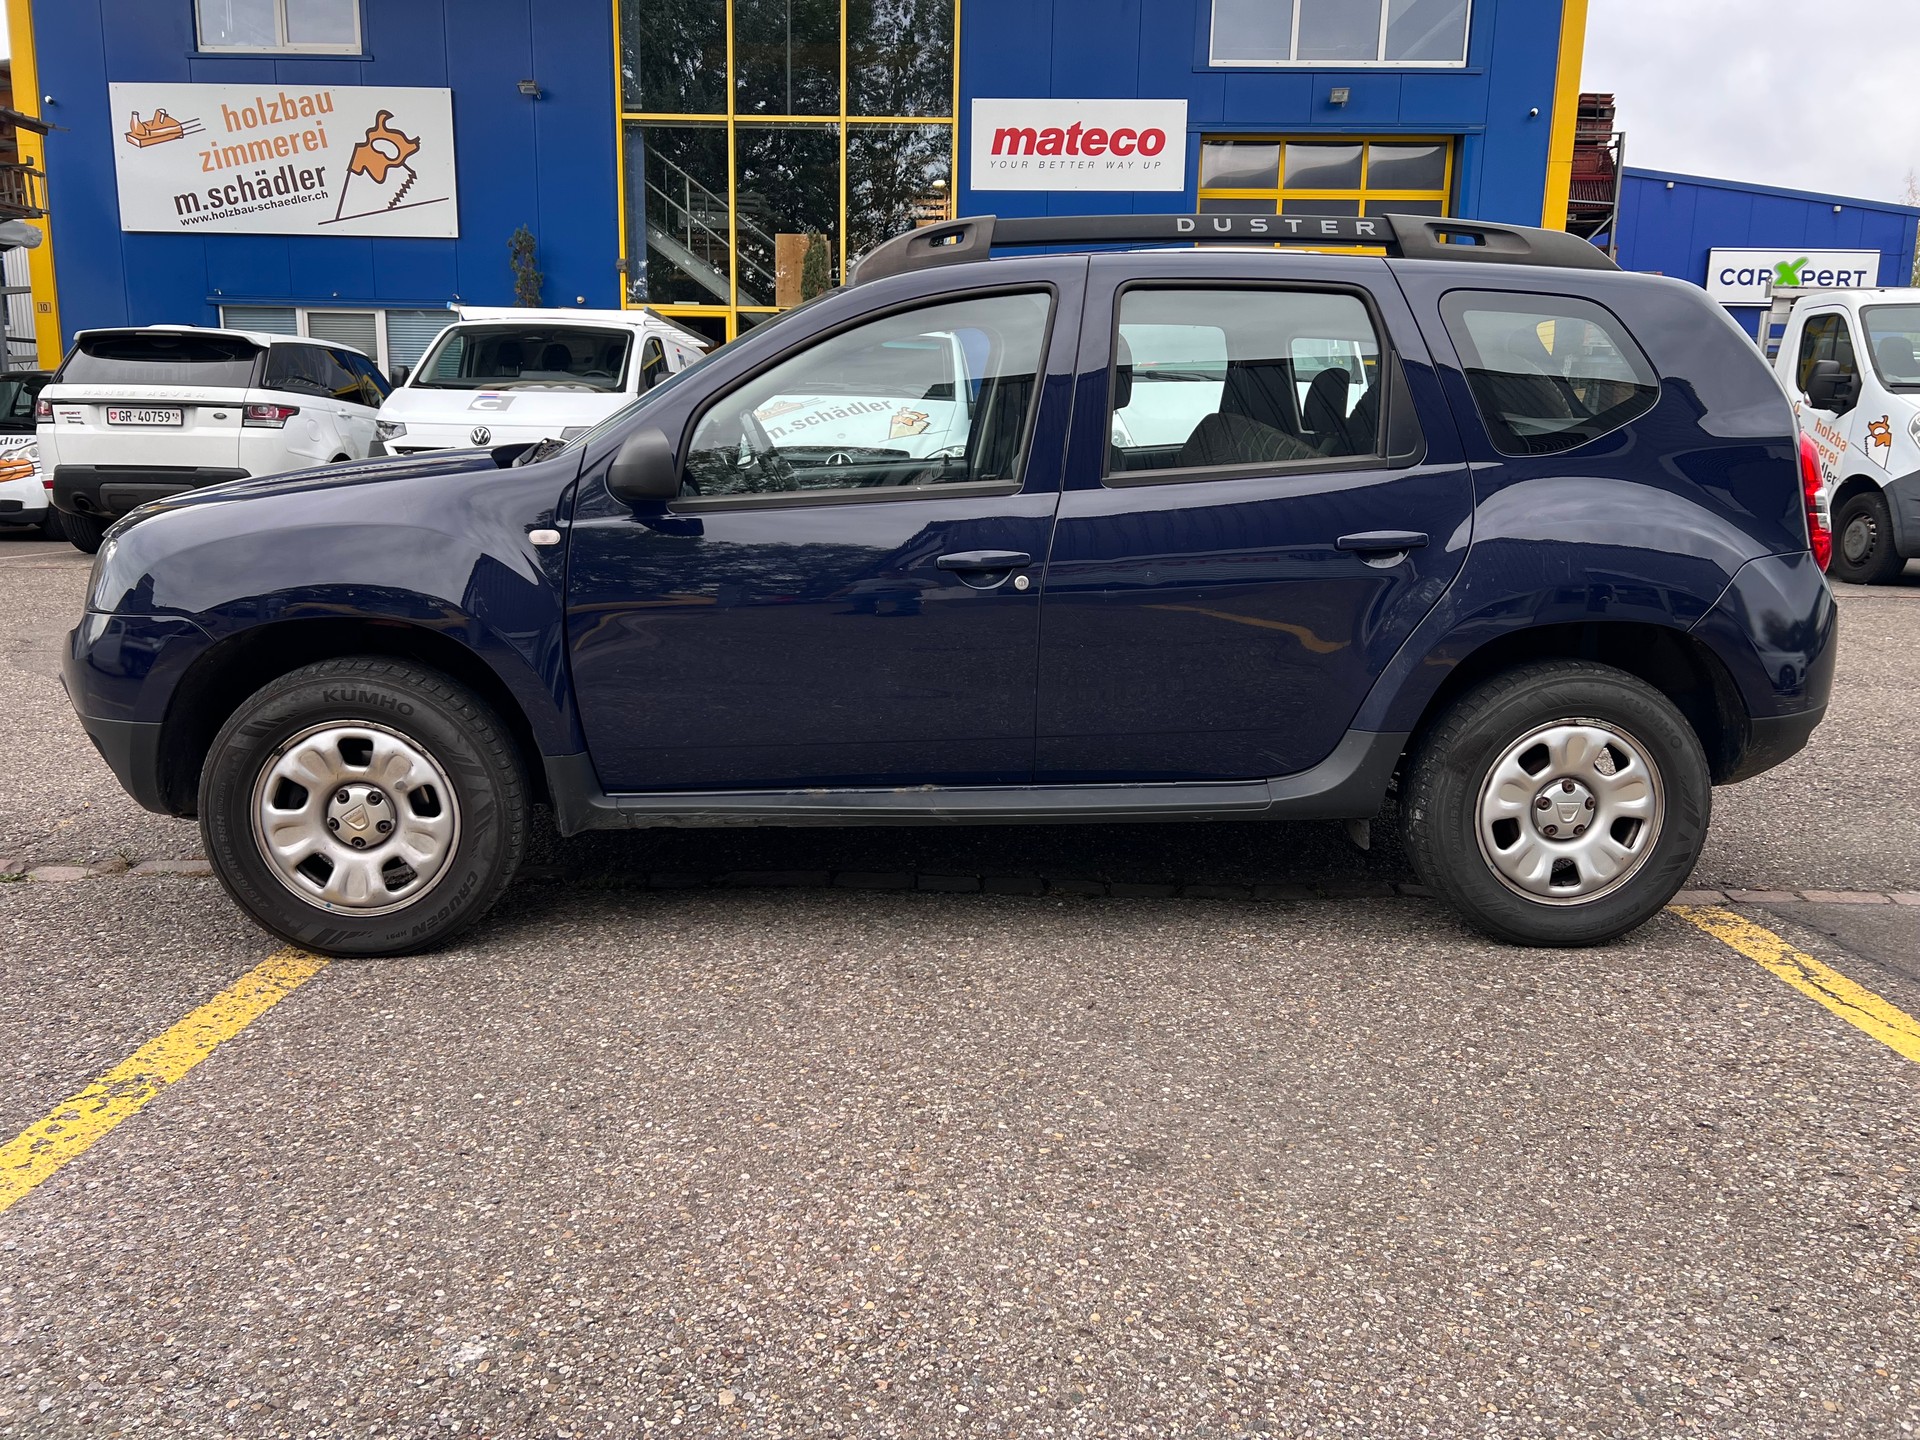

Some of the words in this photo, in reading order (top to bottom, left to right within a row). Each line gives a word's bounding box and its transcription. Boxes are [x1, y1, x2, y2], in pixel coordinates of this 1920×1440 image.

[221, 92, 334, 133] holzbau
[199, 120, 328, 173] zimmerei
[991, 121, 1166, 157] mateco
[990, 161, 1029, 169] YOUR
[1038, 161, 1095, 169] BETTER
[1106, 161, 1134, 170] WAY
[1143, 162, 1161, 170] UP
[173, 164, 326, 216] m.schädler
[180, 190, 329, 226] www.holzbau-schaedler.ch
[1176, 218, 1376, 235] DUSTER
[40, 303, 48, 312] 10
[322, 689, 414, 716] KUMHO
[411, 870, 478, 938] CRUGEN
